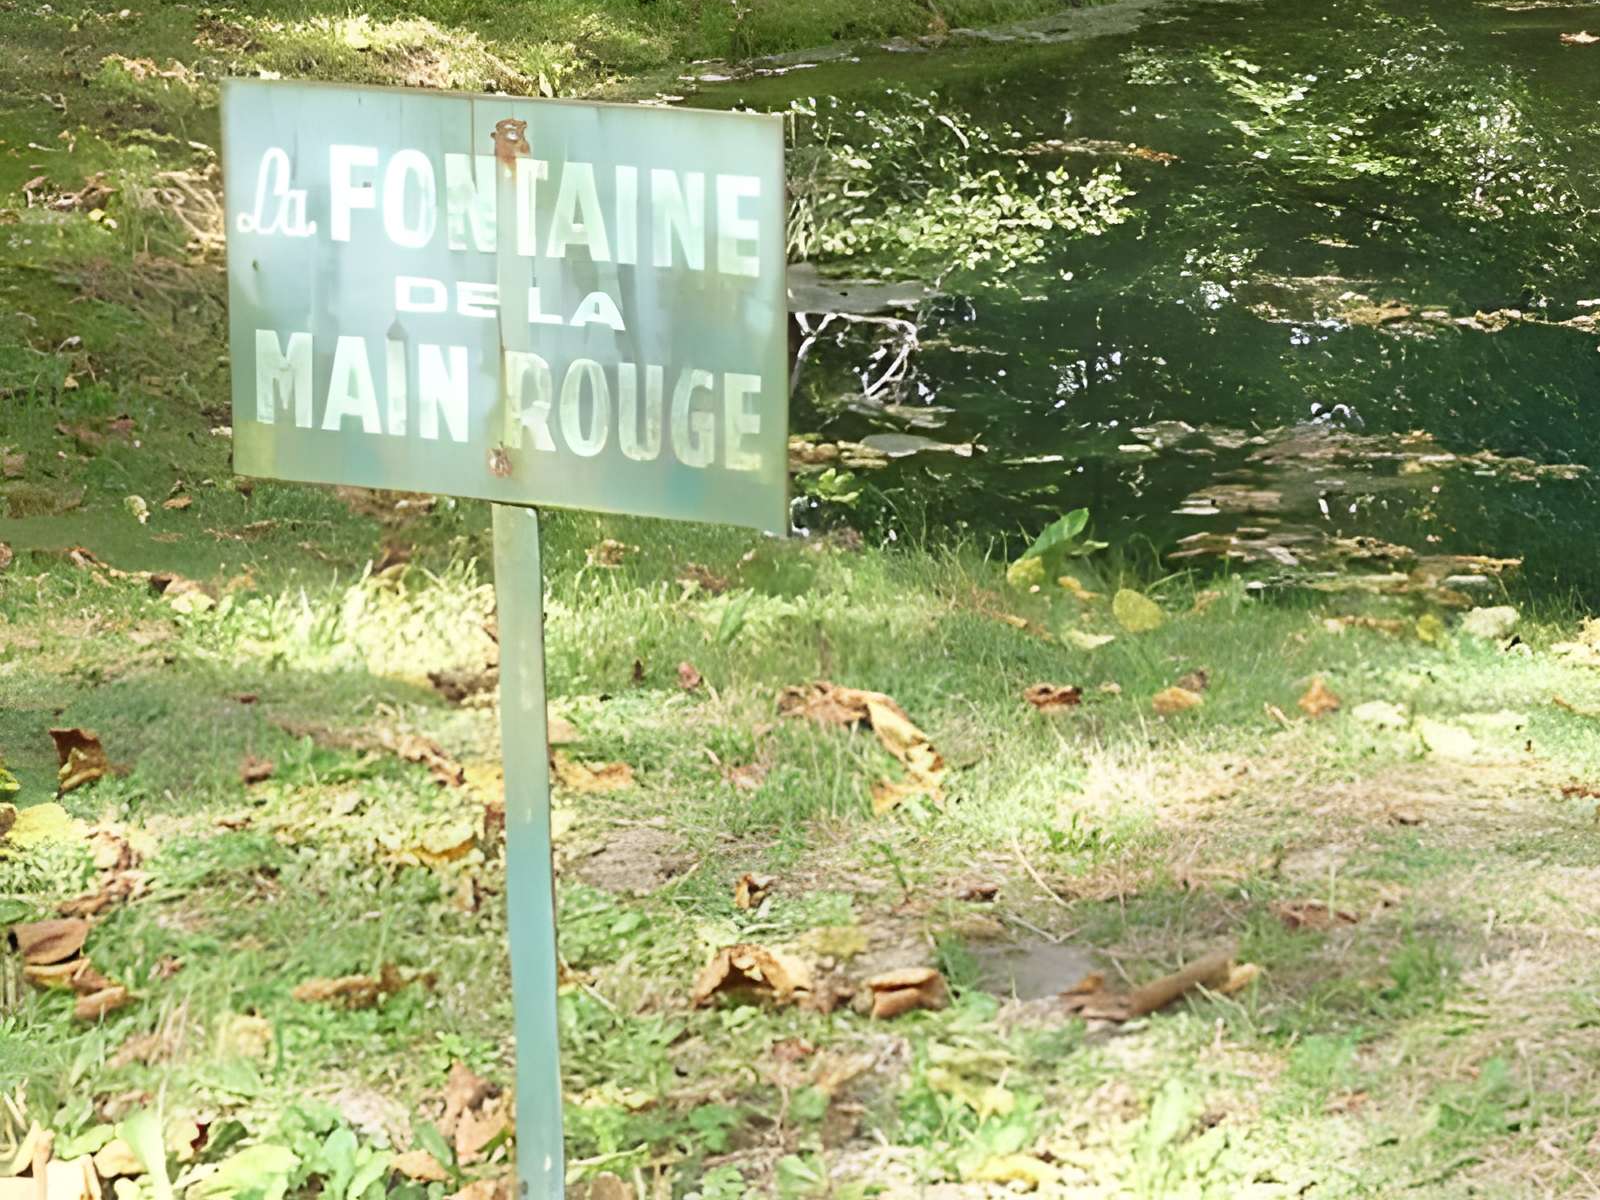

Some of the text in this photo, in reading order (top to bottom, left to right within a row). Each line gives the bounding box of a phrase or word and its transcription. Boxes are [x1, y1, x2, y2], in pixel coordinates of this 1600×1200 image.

[236, 144, 761, 277] La FONTAINE
[395, 277, 626, 330] DE LA
[254, 329, 762, 471] MAIN ROUGE
